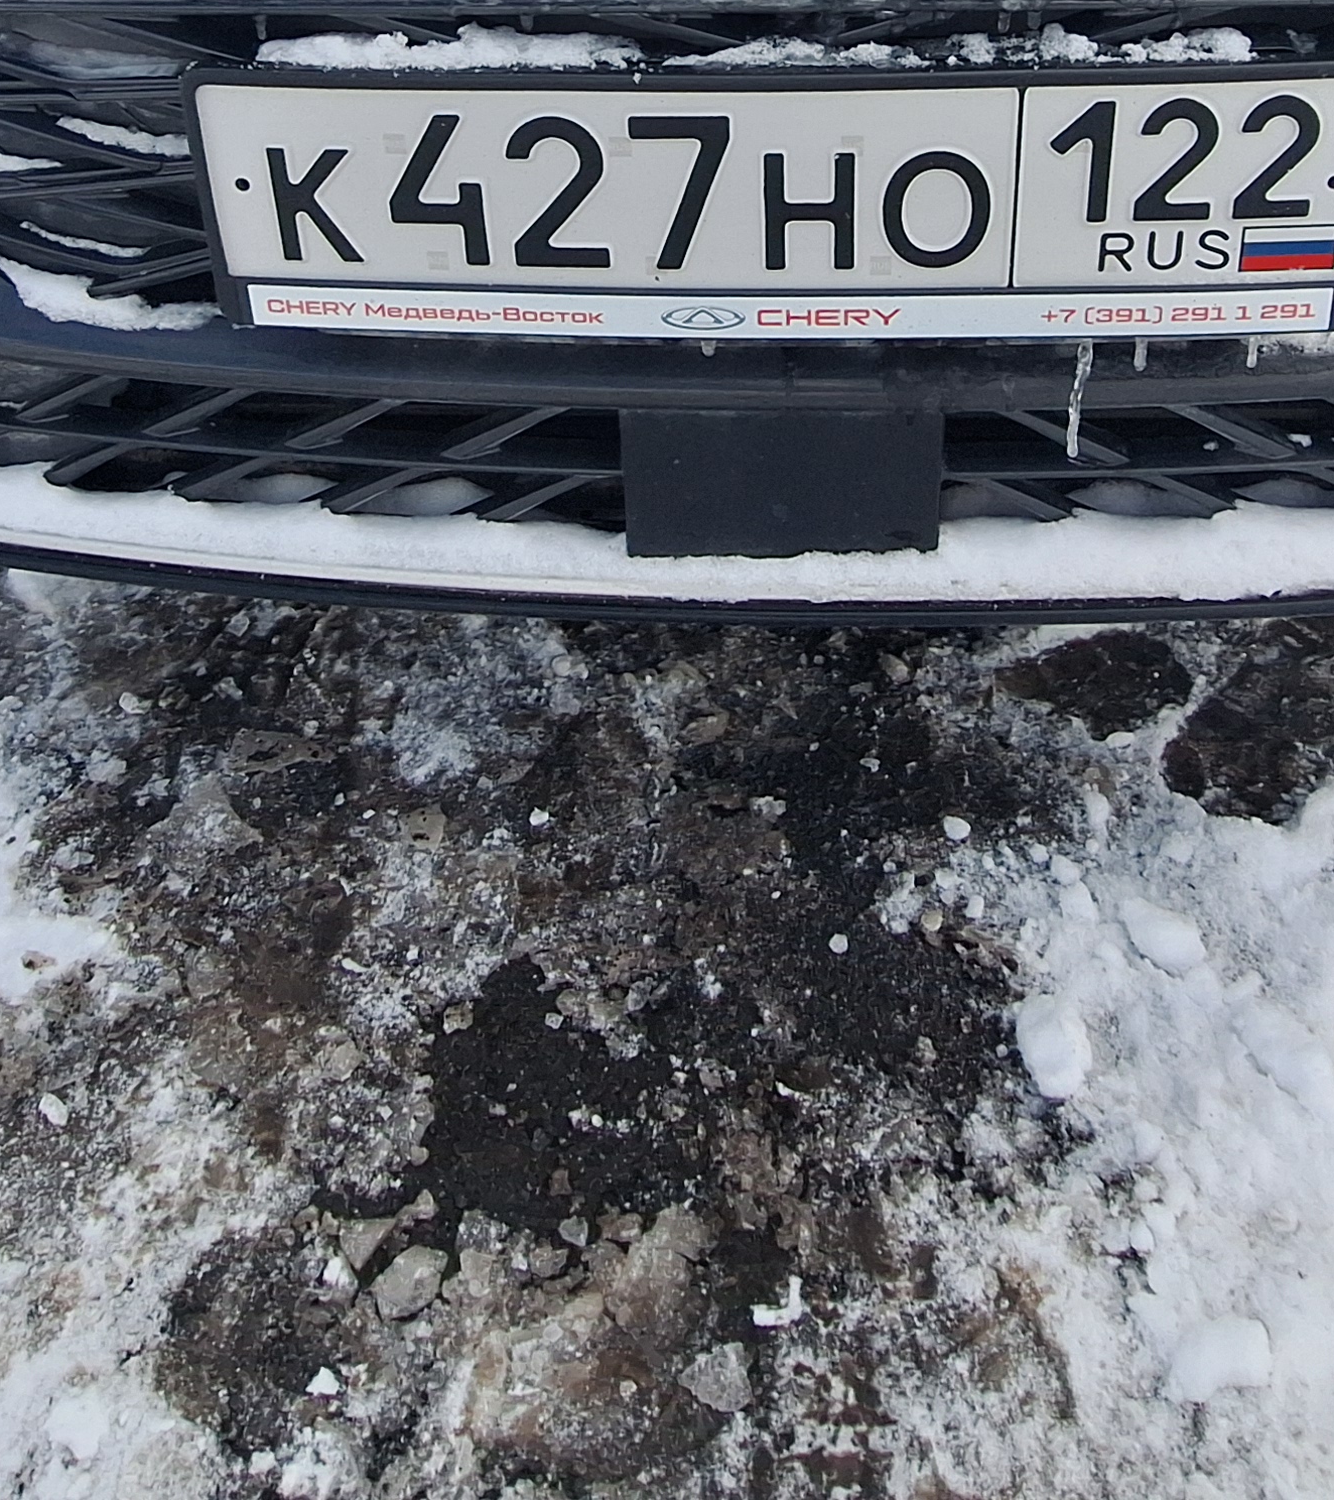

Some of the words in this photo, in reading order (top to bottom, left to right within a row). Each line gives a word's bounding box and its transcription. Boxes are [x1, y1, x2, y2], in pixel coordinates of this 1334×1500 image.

[1049, 94, 1321, 223] 122
[1097, 229, 1231, 273] RUS
[266, 298, 357, 317] CHERY
[364, 302, 604, 325] Медведь-Восток
[756, 307, 902, 328] CHERY
[1040, 308, 1078, 324] +7
[1083, 305, 1164, 325] (391)
[1170, 306, 1227, 323] 291
[1259, 303, 1316, 320] 291
